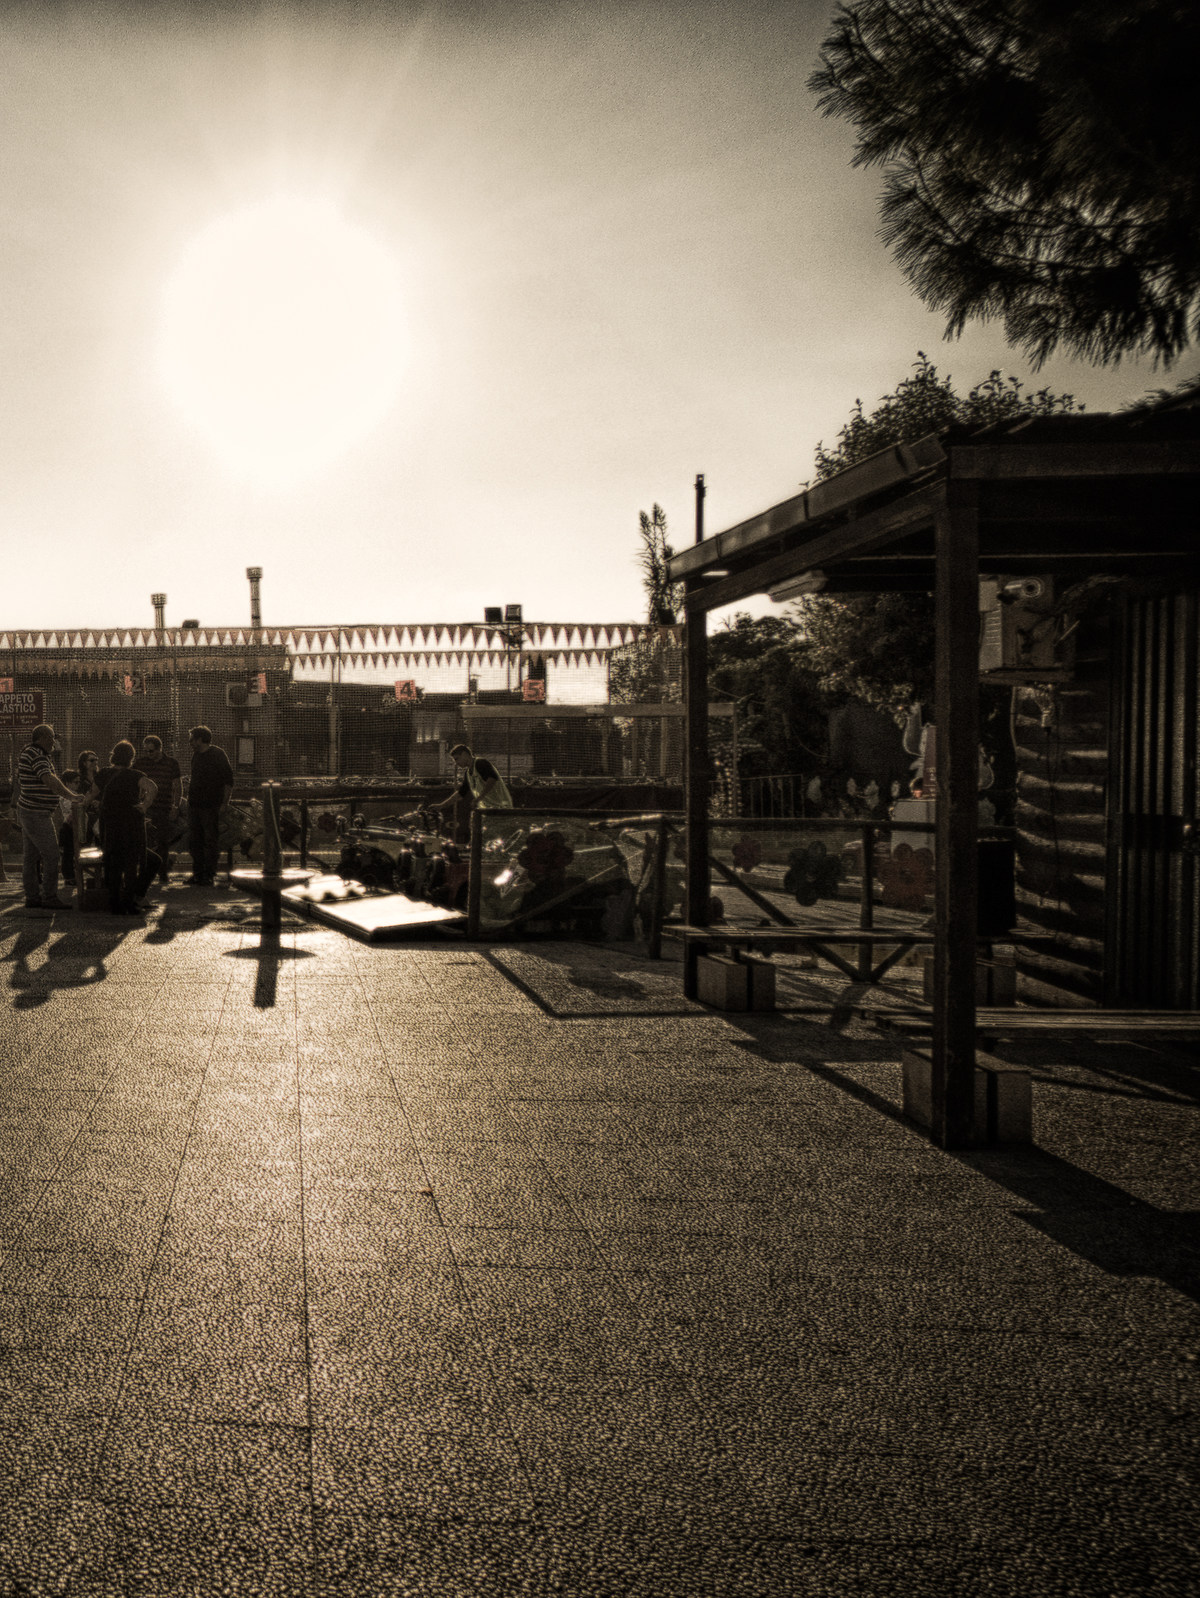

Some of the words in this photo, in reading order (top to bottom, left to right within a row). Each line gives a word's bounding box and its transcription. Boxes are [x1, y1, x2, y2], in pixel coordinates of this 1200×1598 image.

[0, 680, 9, 693] 1
[400, 682, 412, 698] 4
[527, 682, 540, 698] 5
